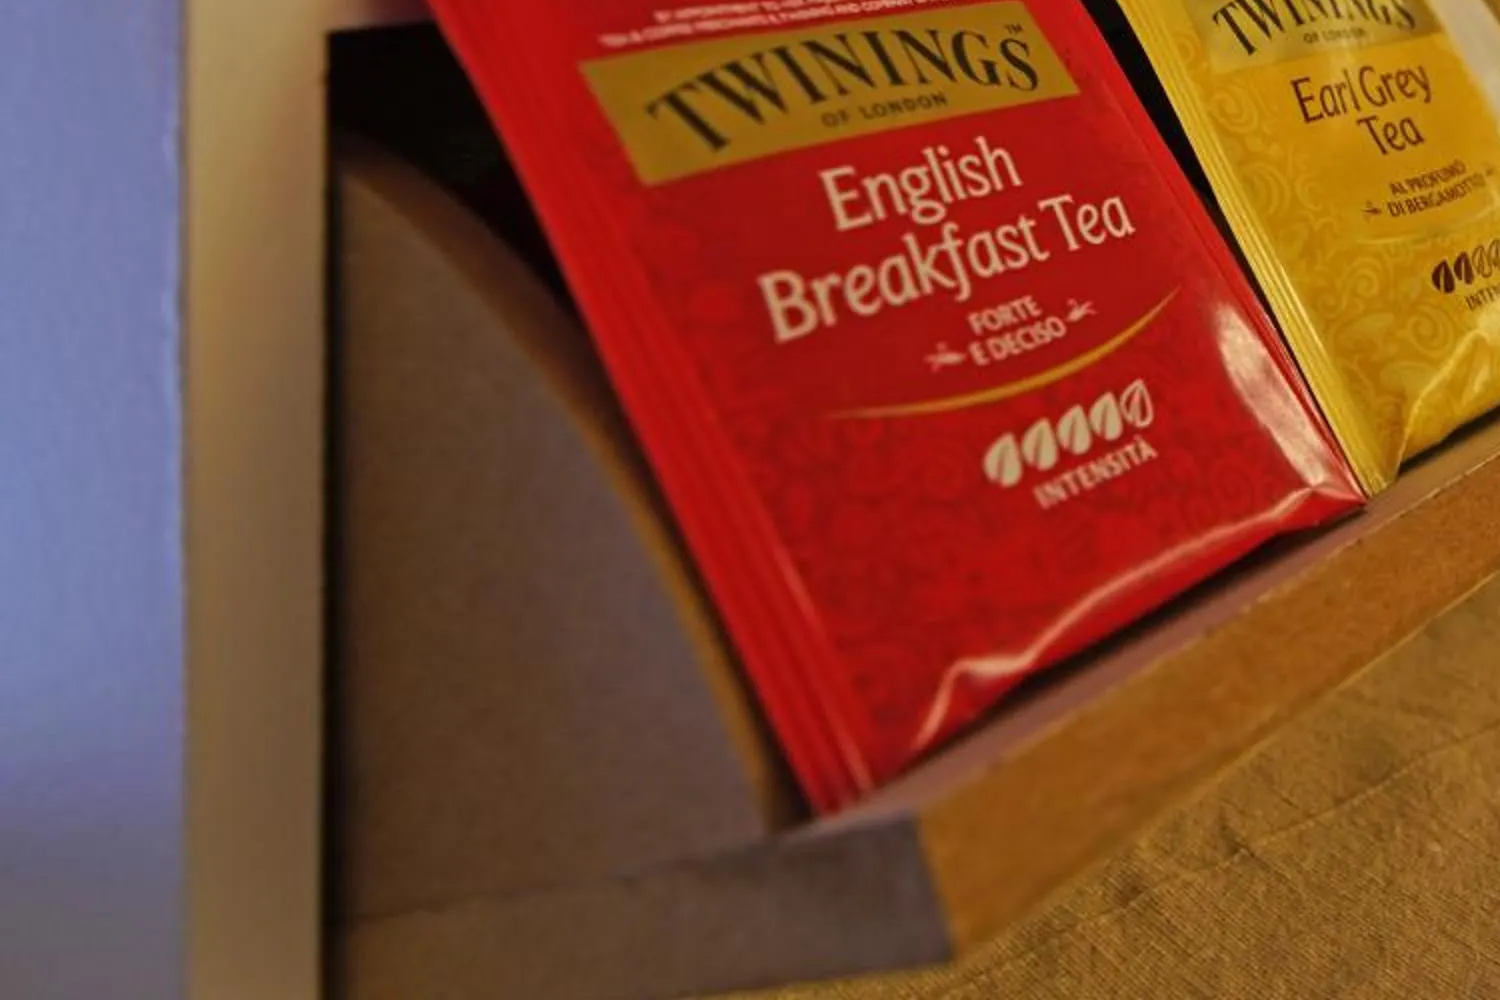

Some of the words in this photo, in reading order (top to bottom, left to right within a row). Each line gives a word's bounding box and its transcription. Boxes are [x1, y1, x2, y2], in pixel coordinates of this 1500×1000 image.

[646, 27, 1039, 152] TWININGS
[821, 110, 849, 138] OF
[858, 91, 948, 131] LONDON
[1290, 67, 1362, 125] Earl
[1358, 64, 1432, 105] Grey
[1356, 115, 1425, 156] Tea
[818, 135, 1023, 232] English
[757, 213, 1050, 344] Breakfast
[1036, 193, 1136, 252] Tea
[966, 294, 1042, 336] FORTE
[968, 340, 990, 367] E
[986, 315, 1067, 361] DECISO
